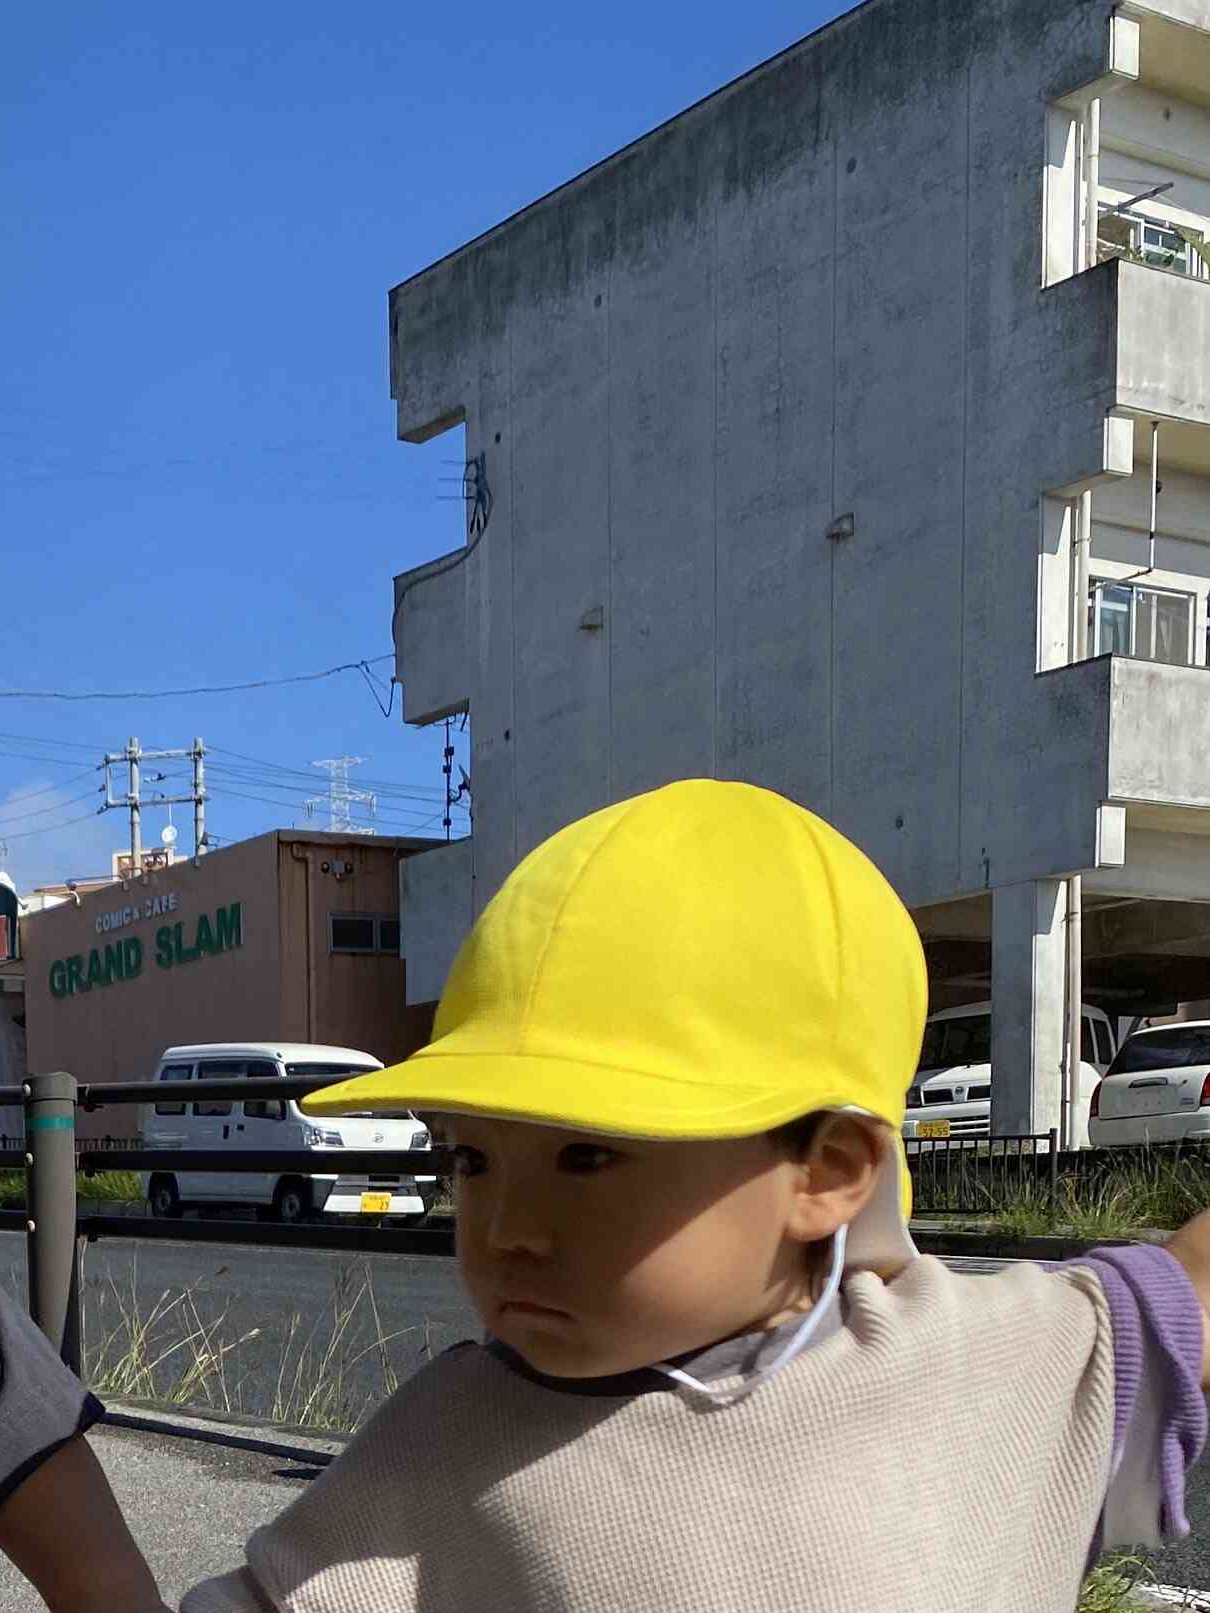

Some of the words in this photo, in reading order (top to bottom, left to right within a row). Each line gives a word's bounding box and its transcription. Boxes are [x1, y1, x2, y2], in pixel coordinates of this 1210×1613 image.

[145, 893, 177, 917] CAFE
[49, 935, 143, 999] GRAND
[156, 901, 246, 970] SLAM
